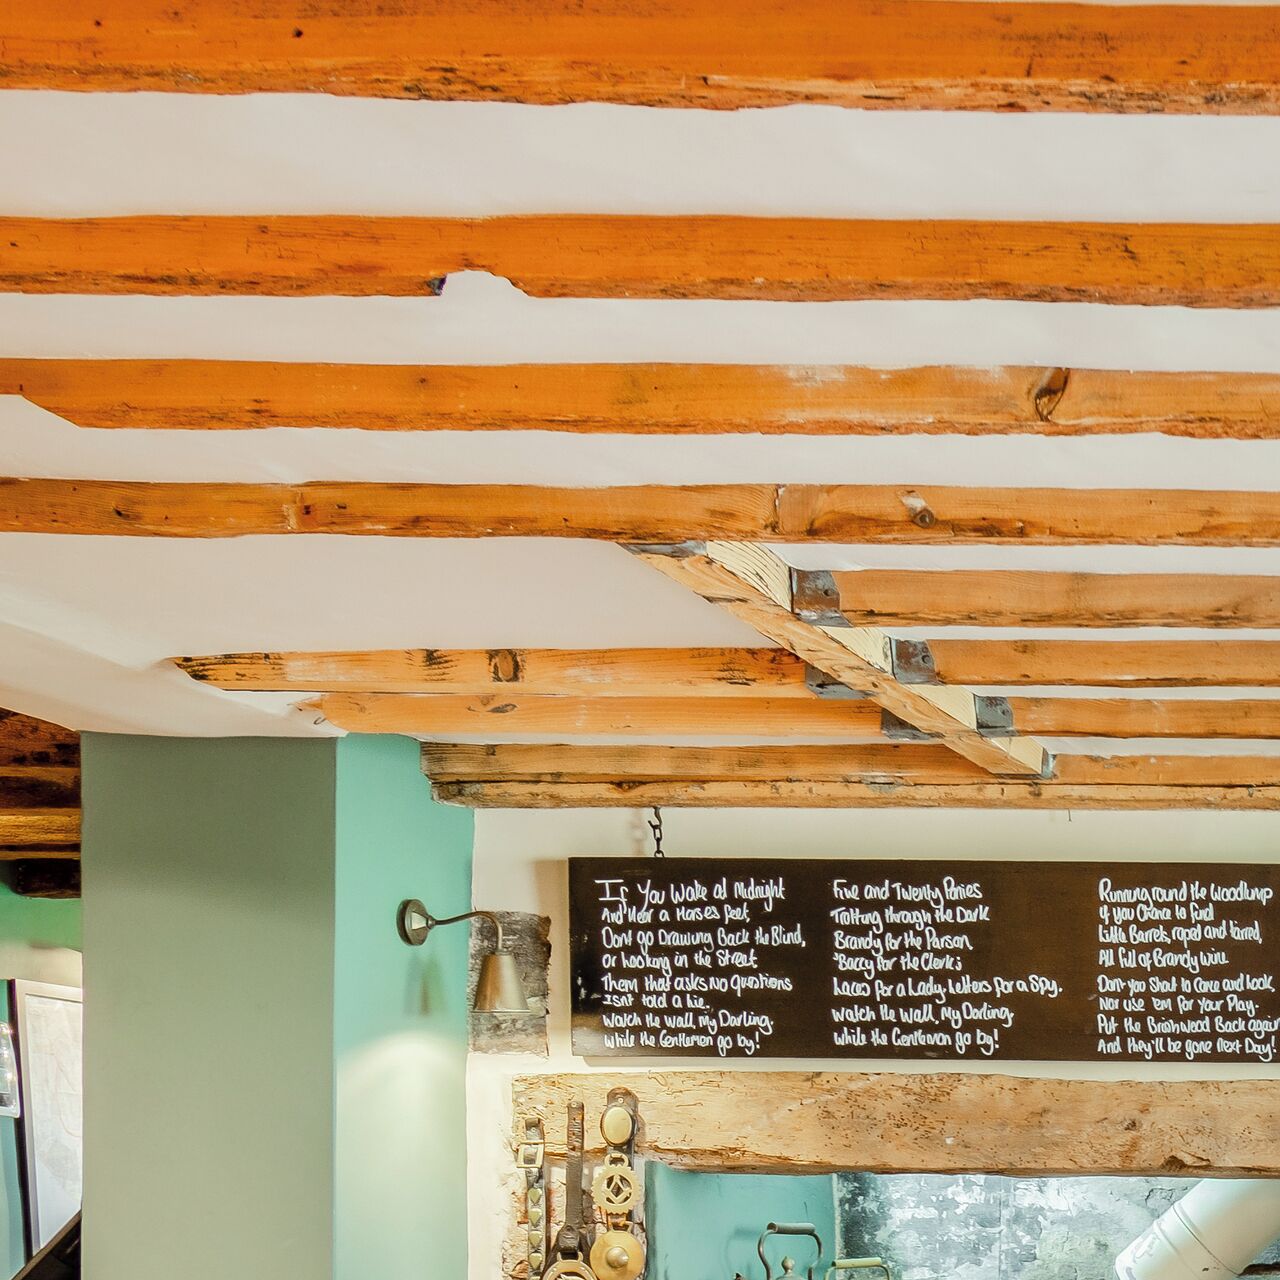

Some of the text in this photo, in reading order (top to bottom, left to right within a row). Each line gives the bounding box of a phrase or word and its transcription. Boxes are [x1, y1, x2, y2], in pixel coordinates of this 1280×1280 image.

[595, 879, 628, 913] If
[833, 879, 859, 900] Five
[864, 879, 890, 899] and
[891, 882, 944, 909] Twenty
[1151, 881, 1187, 902] round
[1190, 881, 1206, 900] the
[659, 909, 670, 922] a
[830, 904, 990, 934] Trotting through the Dark
[1113, 905, 1134, 924] you
[1175, 904, 1187, 919] to
[637, 931, 654, 954] go
[755, 926, 769, 944] the
[834, 930, 883, 956] Brandy
[885, 933, 902, 951] for
[904, 930, 922, 950] the
[1172, 923, 1201, 948] roped
[1204, 920, 1226, 939] and
[675, 950, 712, 968] in the
[877, 955, 897, 972] for
[900, 952, 919, 969] the
[1099, 948, 1200, 972] All of Brandy
[601, 973, 708, 993] Them that asks
[875, 980, 893, 1001] for
[896, 983, 907, 996] a
[993, 977, 1014, 998] for
[1016, 981, 1027, 992] a
[1127, 978, 1145, 997] you
[1181, 976, 1190, 992] to
[1222, 973, 1244, 992] and
[642, 993, 682, 1008] told a
[1177, 995, 1193, 1014] for
[645, 1013, 660, 1028] the
[880, 1004, 896, 1023] the
[1097, 1014, 1119, 1034] Put
[1124, 1017, 1141, 1033] the
[640, 1031, 656, 1047] the
[717, 1037, 732, 1057] go
[737, 1031, 760, 1055] by!
[871, 1028, 1000, 1055] the go by!
[1097, 1036, 1121, 1054] And
[1167, 1037, 1181, 1053] be
[1185, 1039, 1212, 1060] gone
